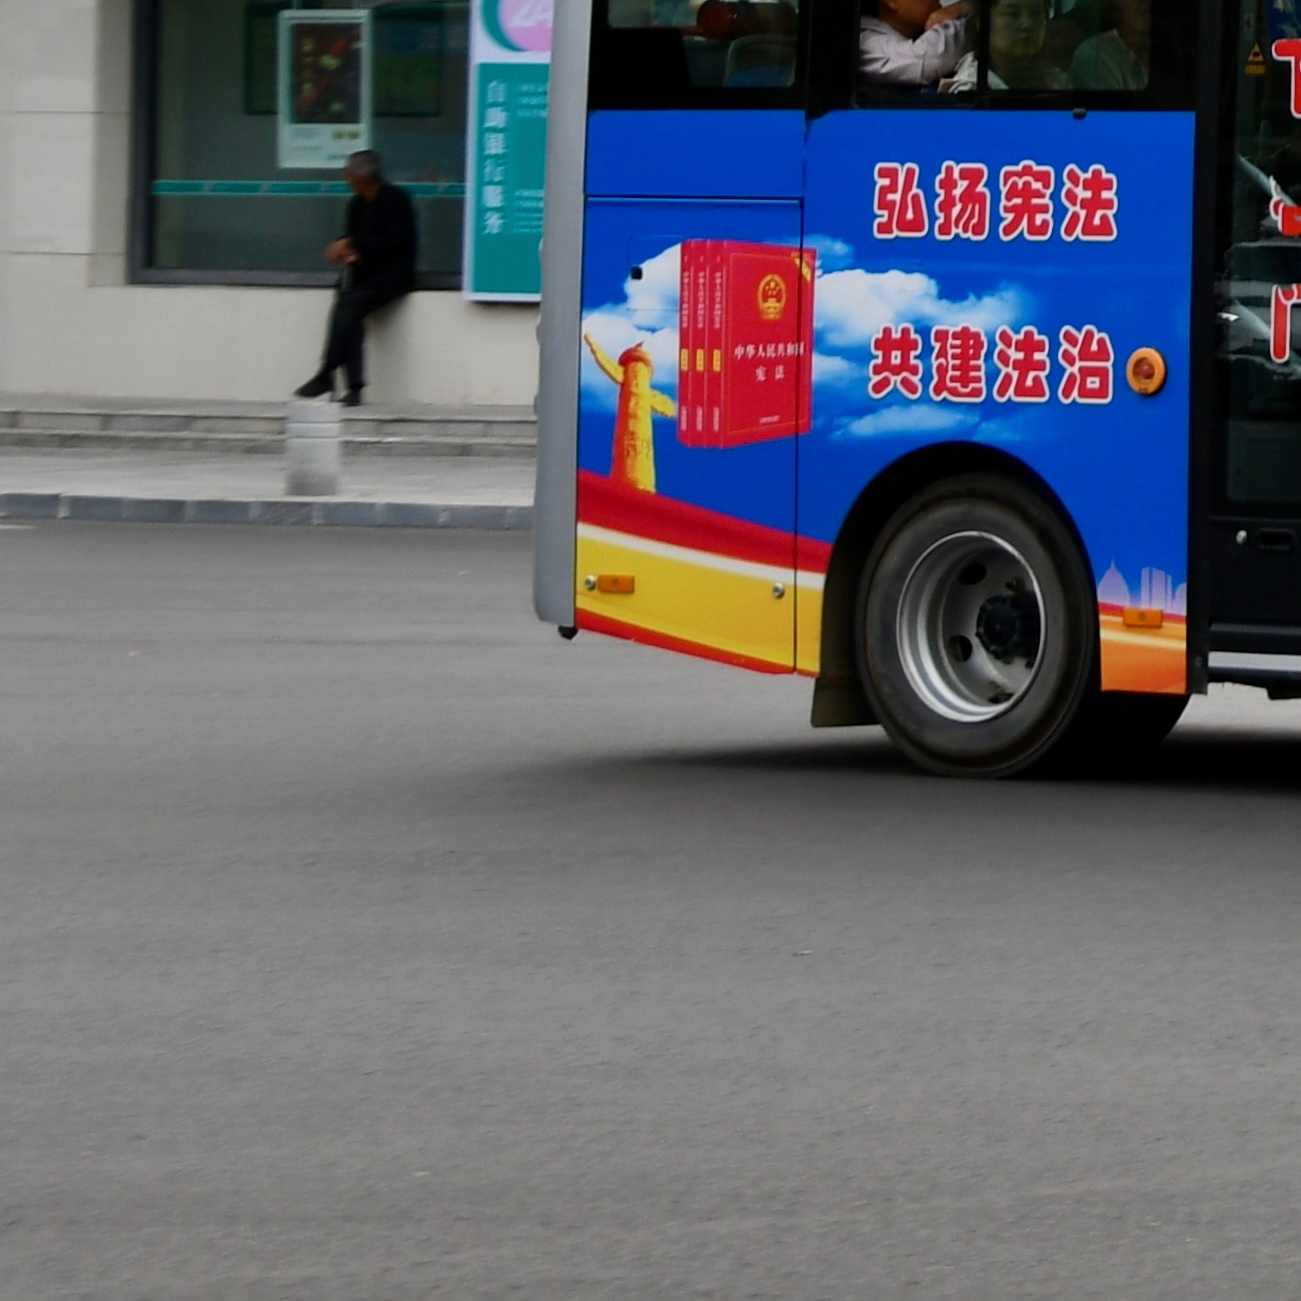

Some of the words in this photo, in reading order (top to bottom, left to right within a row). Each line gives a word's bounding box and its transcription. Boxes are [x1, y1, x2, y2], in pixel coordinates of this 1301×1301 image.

[874, 161, 1118, 241] 弘扬宪法
[868, 323, 1114, 404] 共建法治
